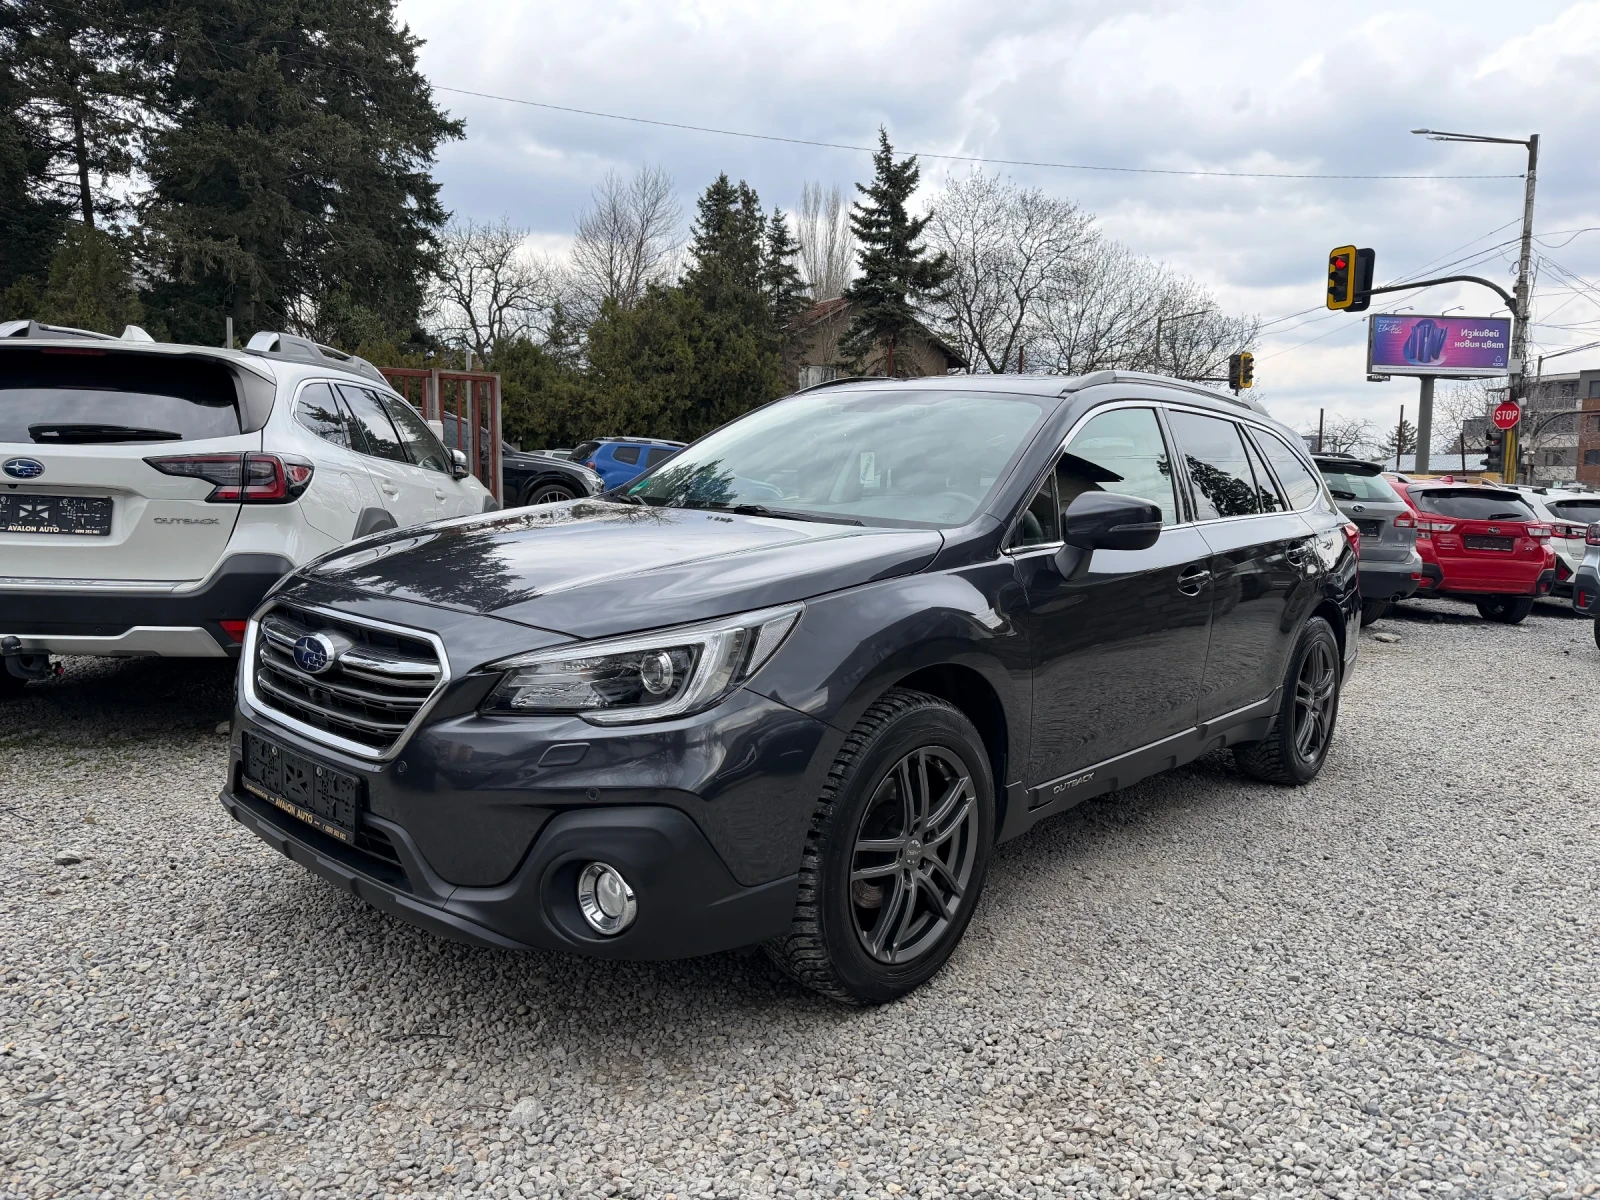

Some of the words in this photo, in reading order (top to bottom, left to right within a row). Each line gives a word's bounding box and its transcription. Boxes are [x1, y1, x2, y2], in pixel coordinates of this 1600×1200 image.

[1460, 328, 1500, 339] Изживей
[1454, 339, 1480, 348] новия
[1481, 340, 1504, 349] цвят
[1495, 410, 1518, 420] STOP
[1053, 772, 1095, 795] OUTBACK
[275, 797, 296, 815] AVALON
[296, 809, 313, 824] AUTO
